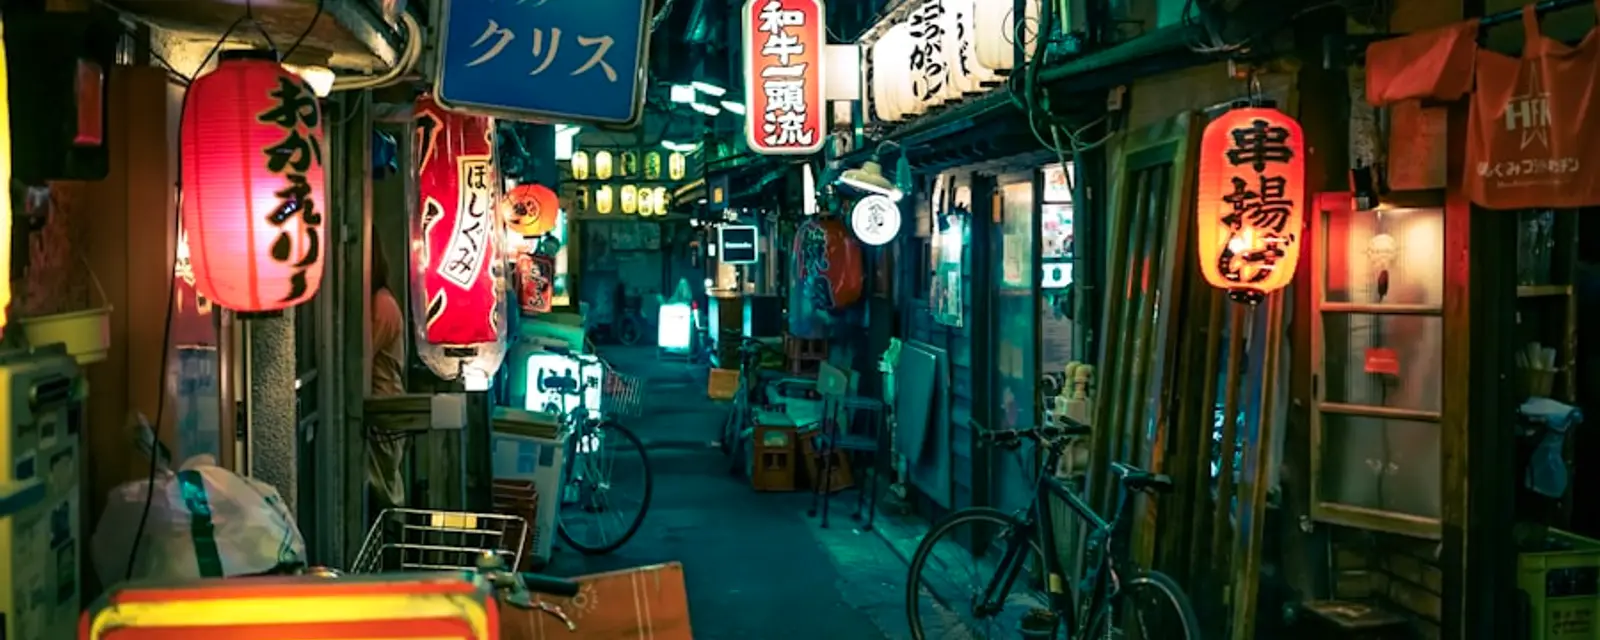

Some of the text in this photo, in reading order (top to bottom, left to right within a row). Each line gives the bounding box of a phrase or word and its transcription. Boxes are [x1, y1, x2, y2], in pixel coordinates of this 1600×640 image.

[464, 19, 618, 83] クリス
[759, 0, 813, 146] 和牛一頭流
[446, 164, 487, 276] ほしぐみ
[1218, 119, 1295, 283] 串揚げ
